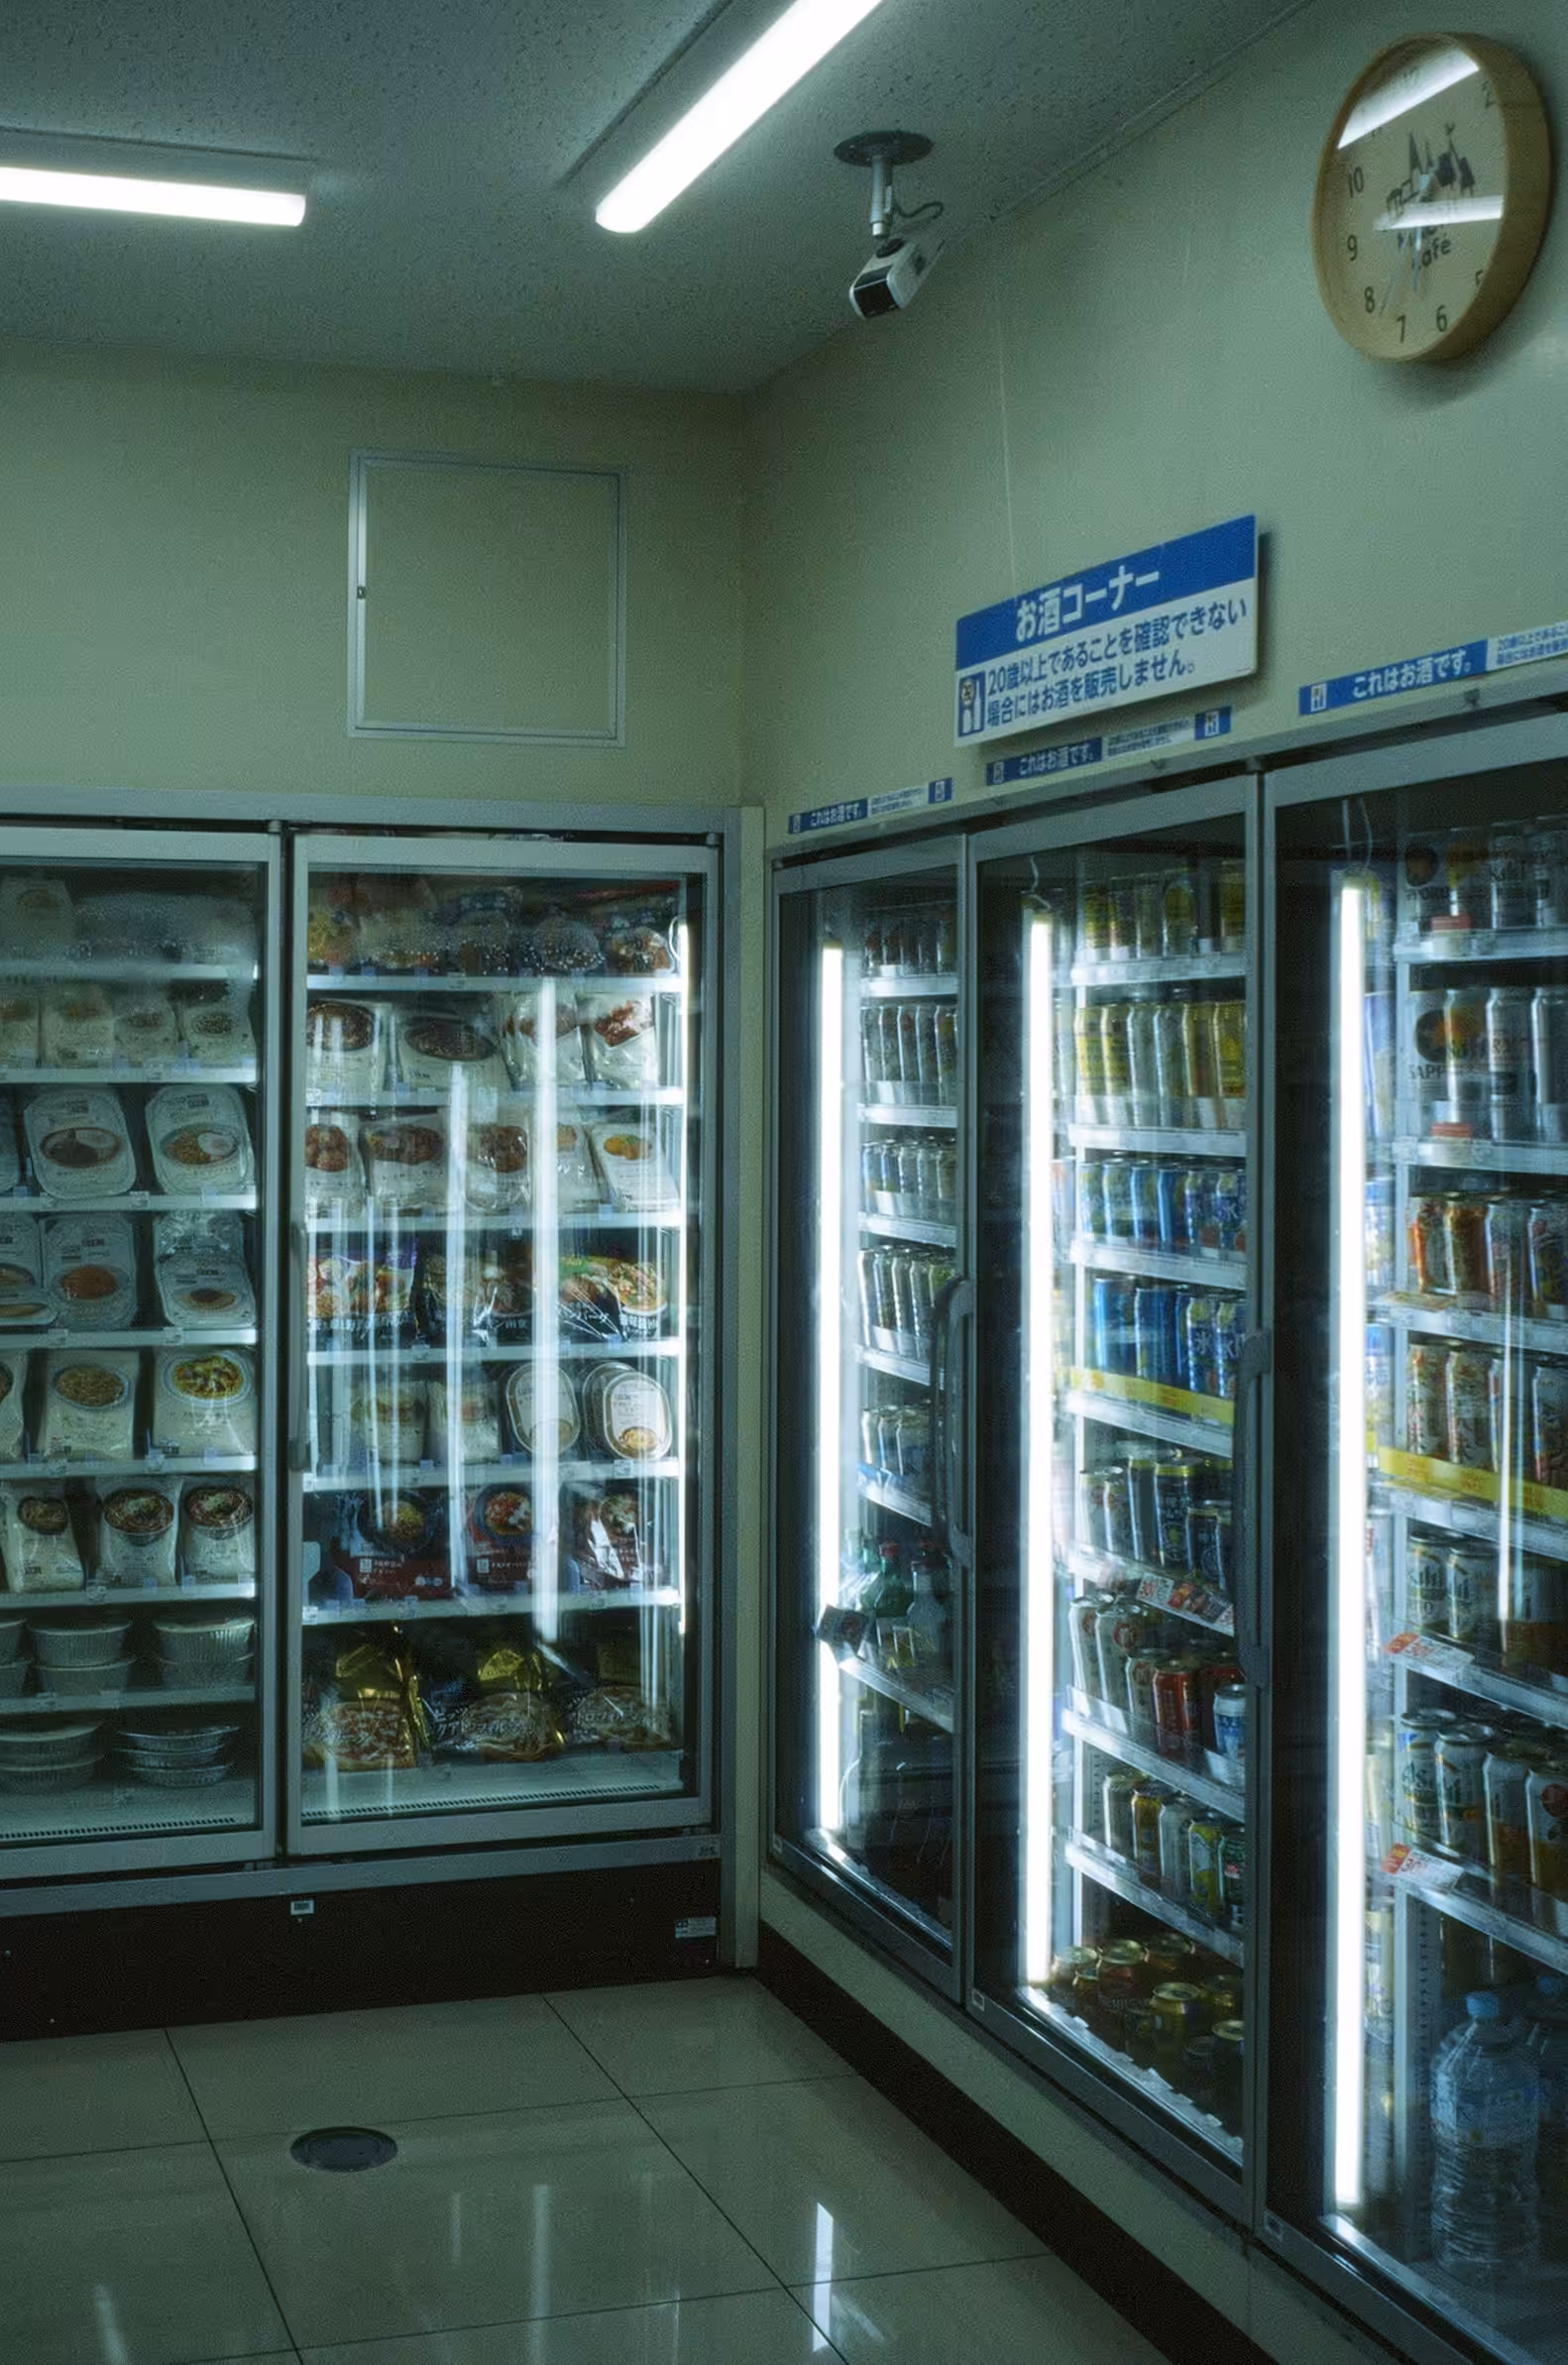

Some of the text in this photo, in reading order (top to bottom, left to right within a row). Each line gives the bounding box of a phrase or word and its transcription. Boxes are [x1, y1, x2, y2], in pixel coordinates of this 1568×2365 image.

[1347, 167, 1364, 197] 10
[1347, 234, 1358, 261] 9
[1364, 286, 1375, 313] 8
[1397, 314, 1406, 343] 7
[1436, 304, 1447, 332] 6
[1016, 564, 1160, 642] お酒コーナー
[988, 599, 1247, 696] 20歳以上であることを確認できない
[987, 649, 1195, 727] 場合にはお酒を販売しません。
[1353, 650, 1471, 698] これはお酒です。
